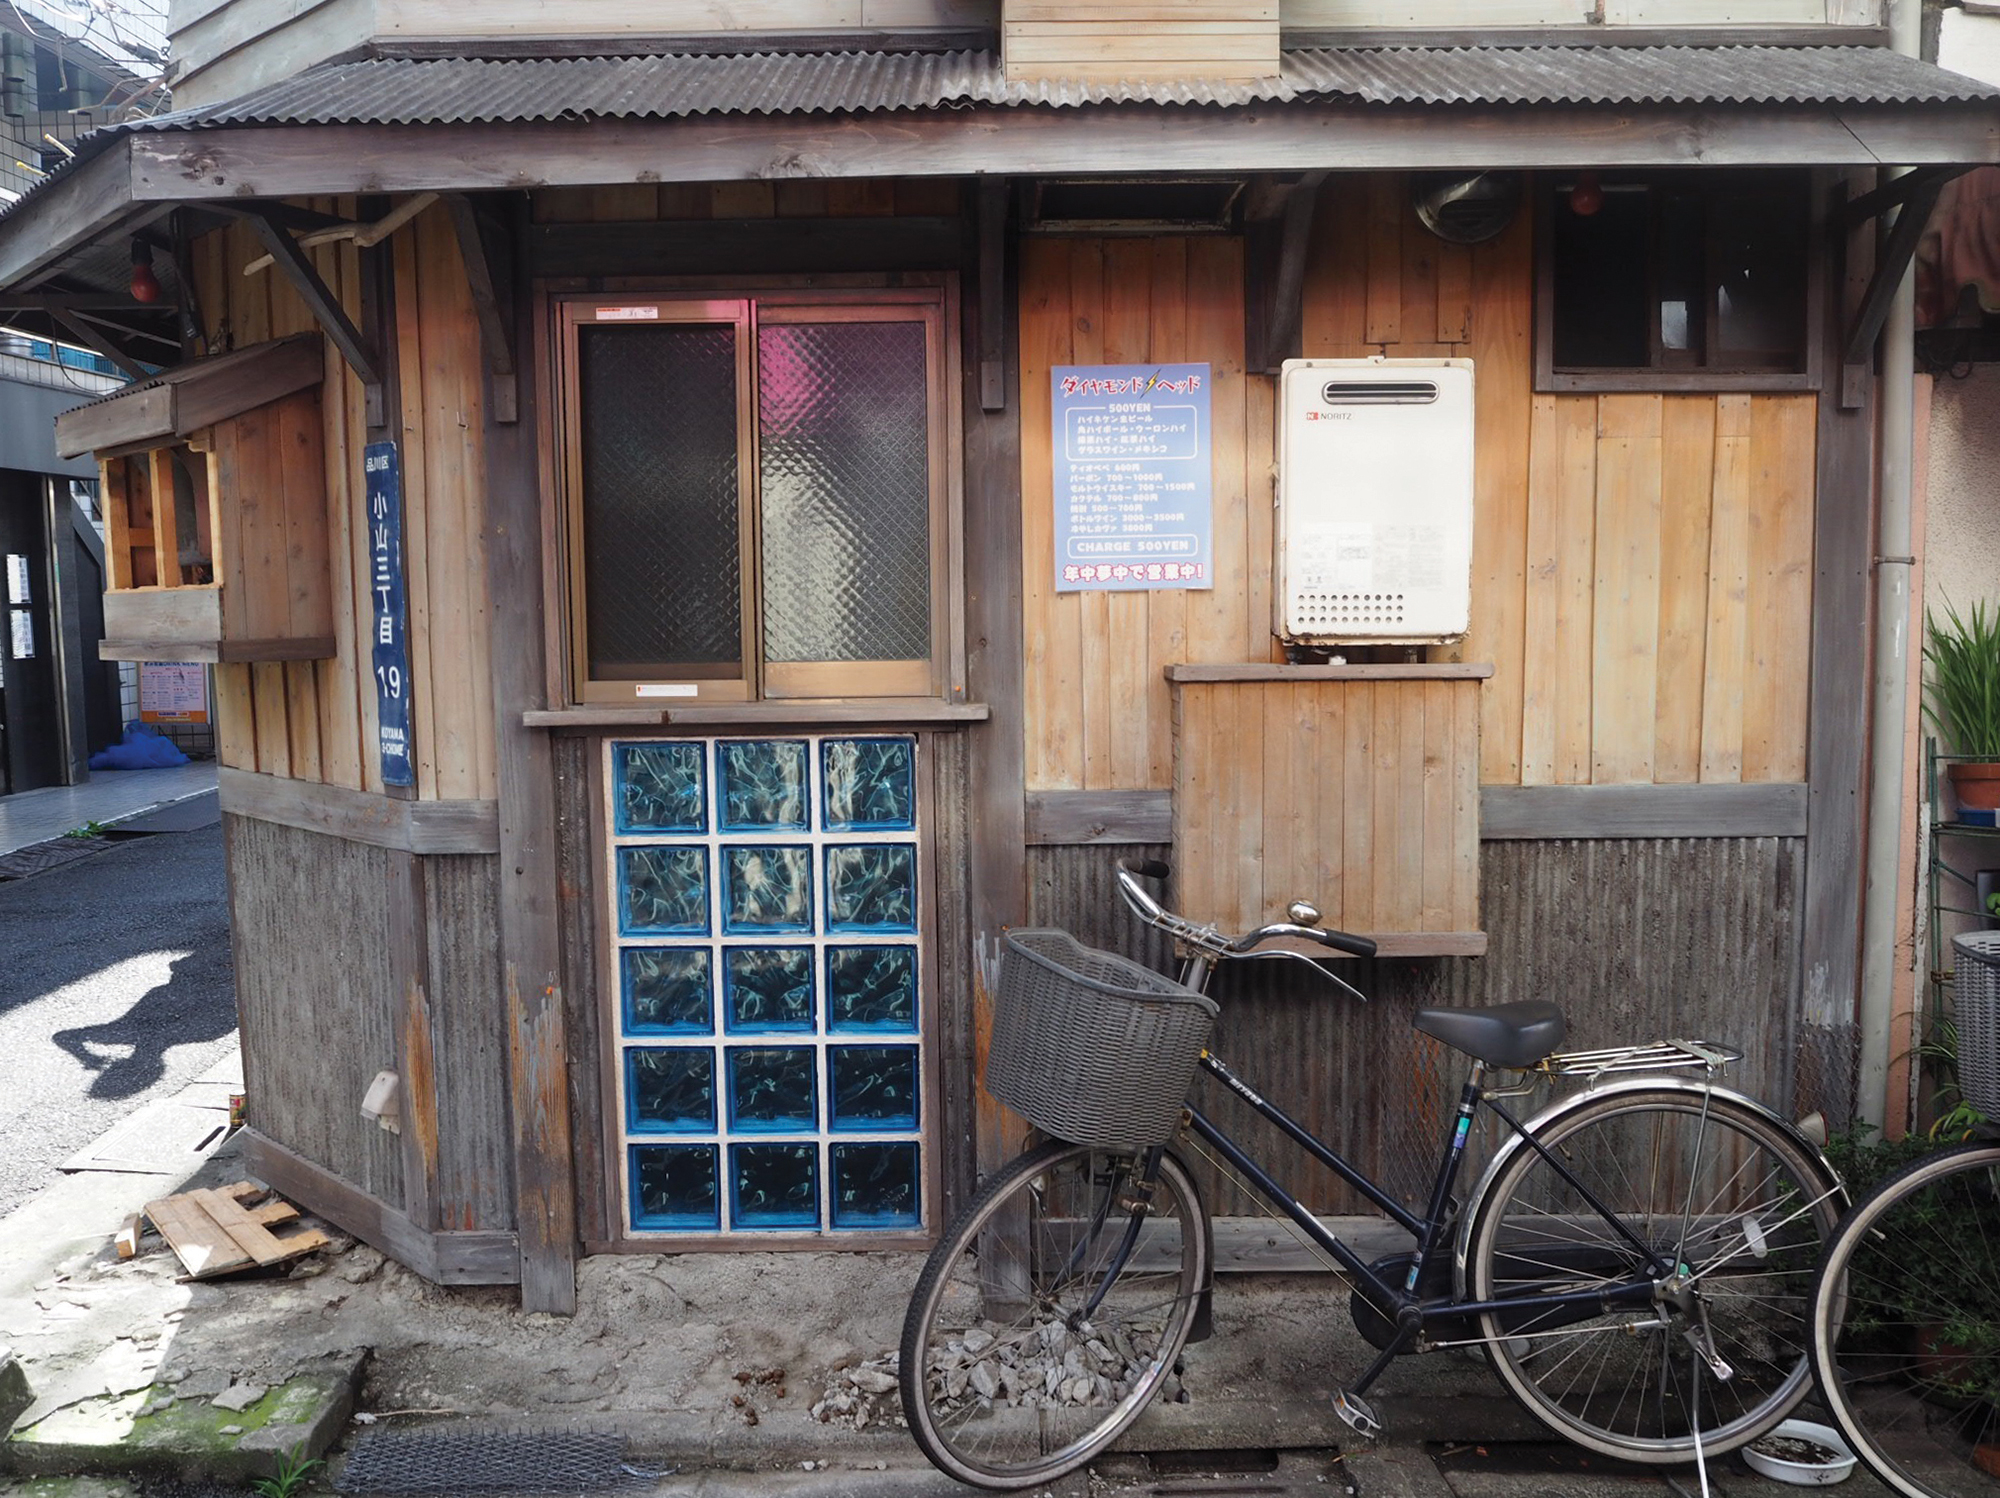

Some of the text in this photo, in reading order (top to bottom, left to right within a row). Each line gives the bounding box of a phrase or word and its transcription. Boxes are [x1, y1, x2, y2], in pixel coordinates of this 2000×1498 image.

[1109, 403, 1151, 413] 500YEN
[1321, 412, 1352, 420] NORITZ
[366, 455, 389, 472] 品川区
[1077, 541, 1189, 552] CHARGE 500YEN
[374, 491, 401, 698] 小山三丁目 19
[381, 726, 404, 741] KOYAMA
[381, 743, 404, 757] 3-CHOME
